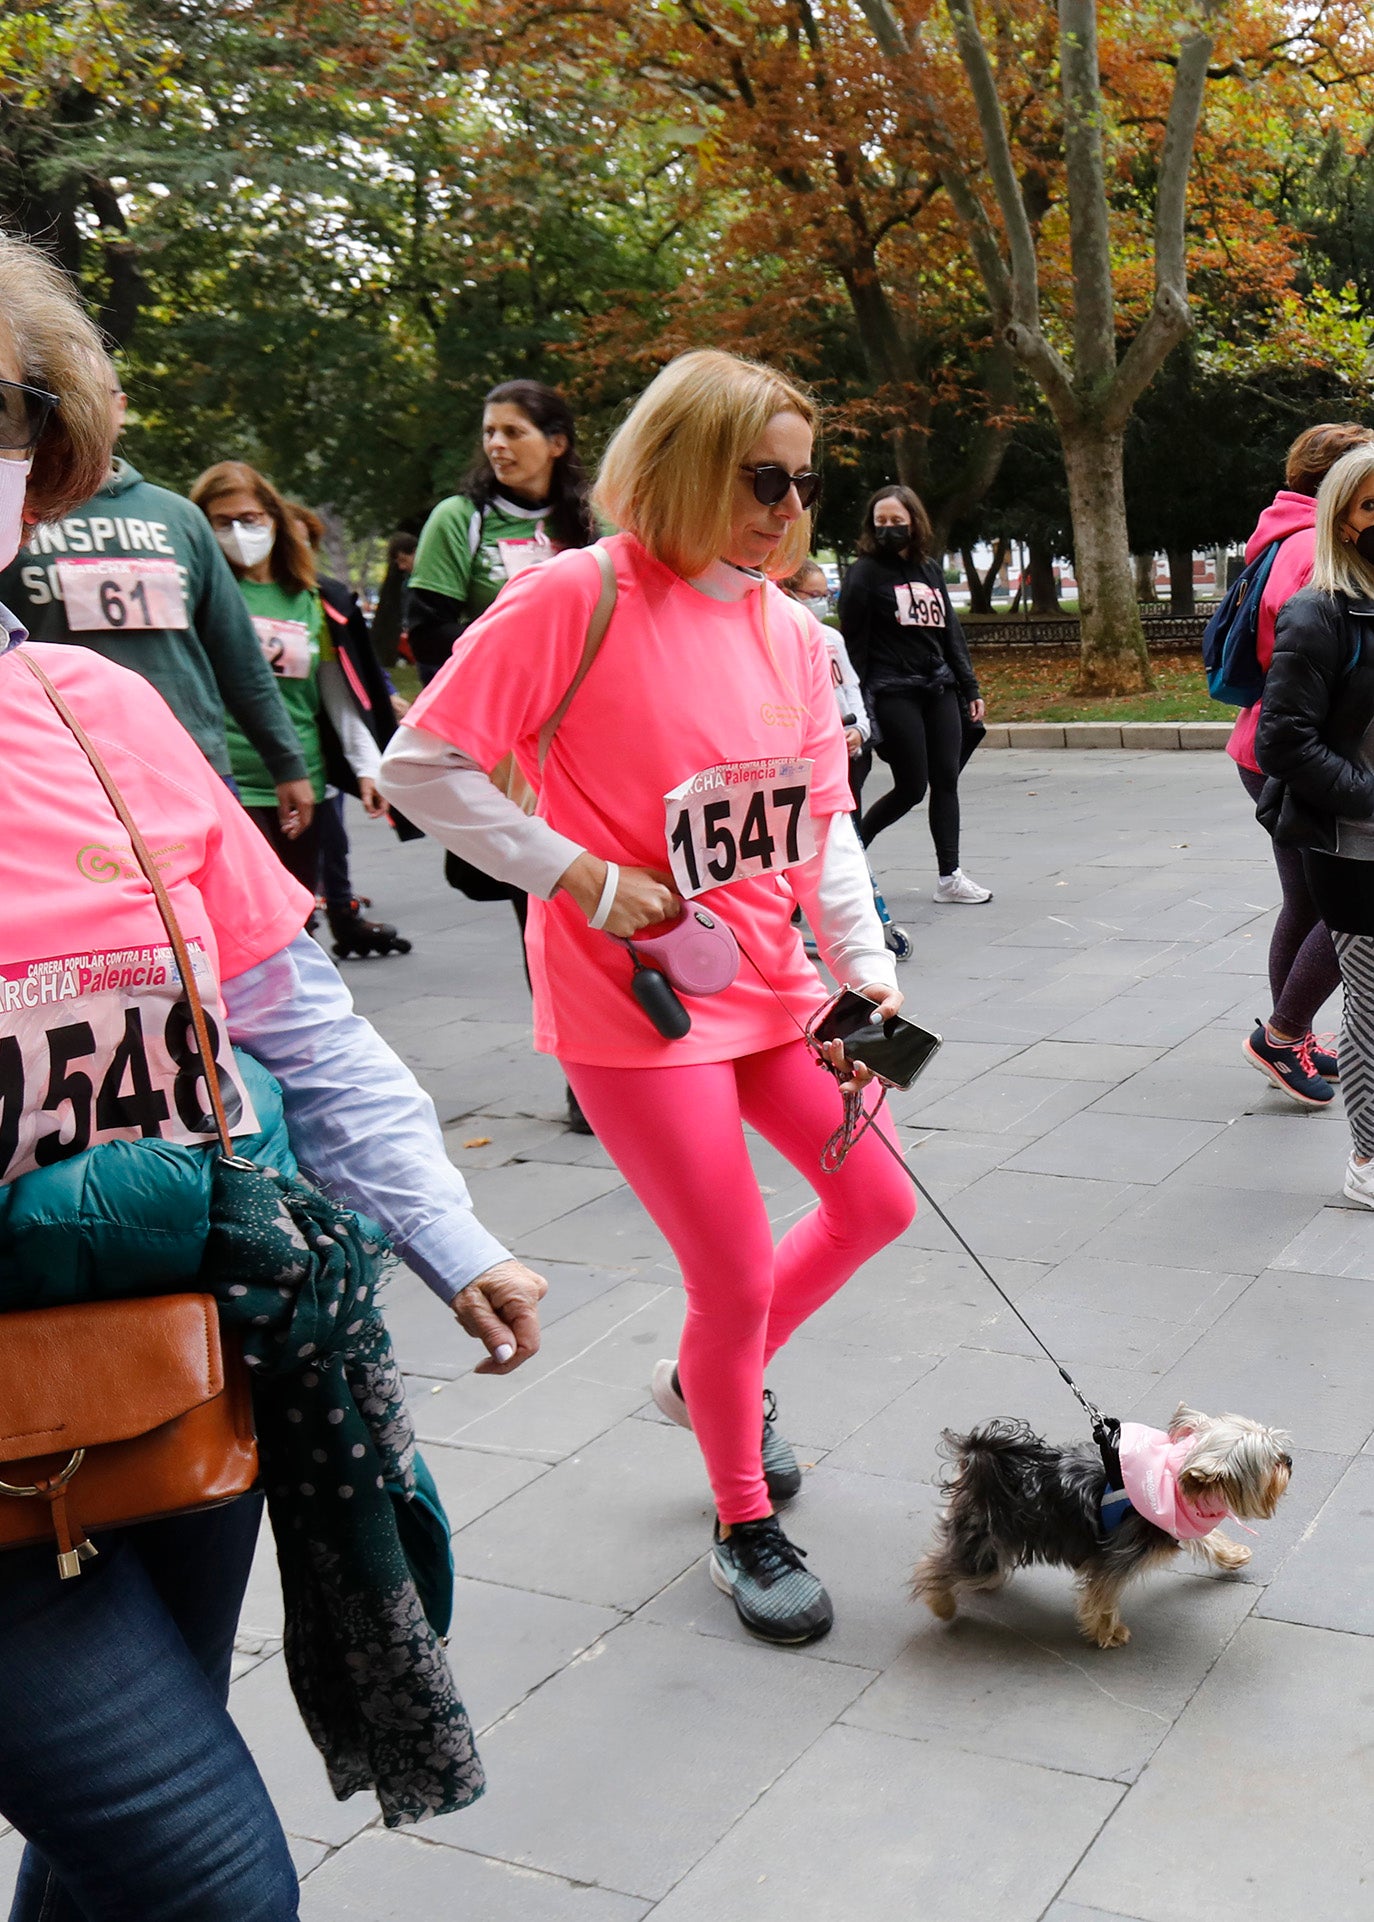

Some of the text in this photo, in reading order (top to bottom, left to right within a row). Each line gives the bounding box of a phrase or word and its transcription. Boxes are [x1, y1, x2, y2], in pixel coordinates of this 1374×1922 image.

[100, 580, 152, 627] 61
[908, 599, 940, 625] 496
[725, 767, 776, 786] Palencia
[671, 785, 807, 890] 1547
[27, 959, 62, 978] CARRERA
[64, 954, 105, 972] POPULAR
[106, 950, 139, 966] CONTRA
[142, 949, 152, 961] EL
[79, 962, 167, 996] Palencia
